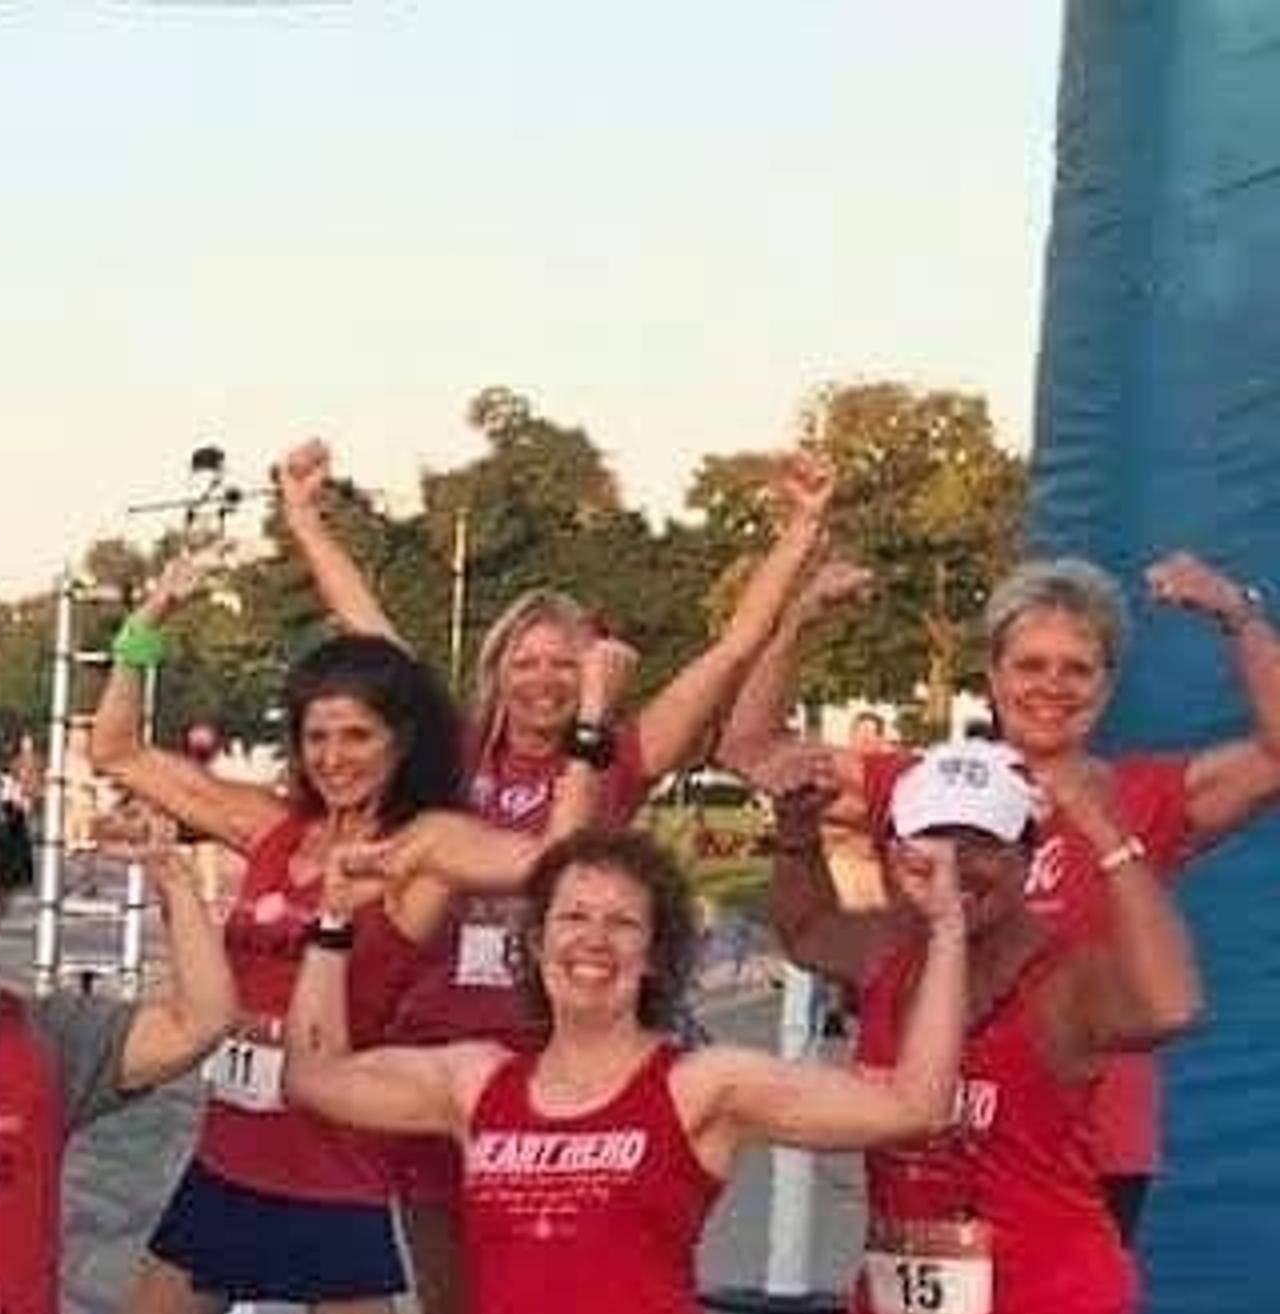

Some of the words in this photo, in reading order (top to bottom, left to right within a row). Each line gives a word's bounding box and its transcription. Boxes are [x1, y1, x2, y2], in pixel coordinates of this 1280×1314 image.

[227, 1045, 254, 1086] 11
[466, 1129, 574, 1173] HEART
[558, 1129, 648, 1173] HERO
[896, 1262, 944, 1311] 15
